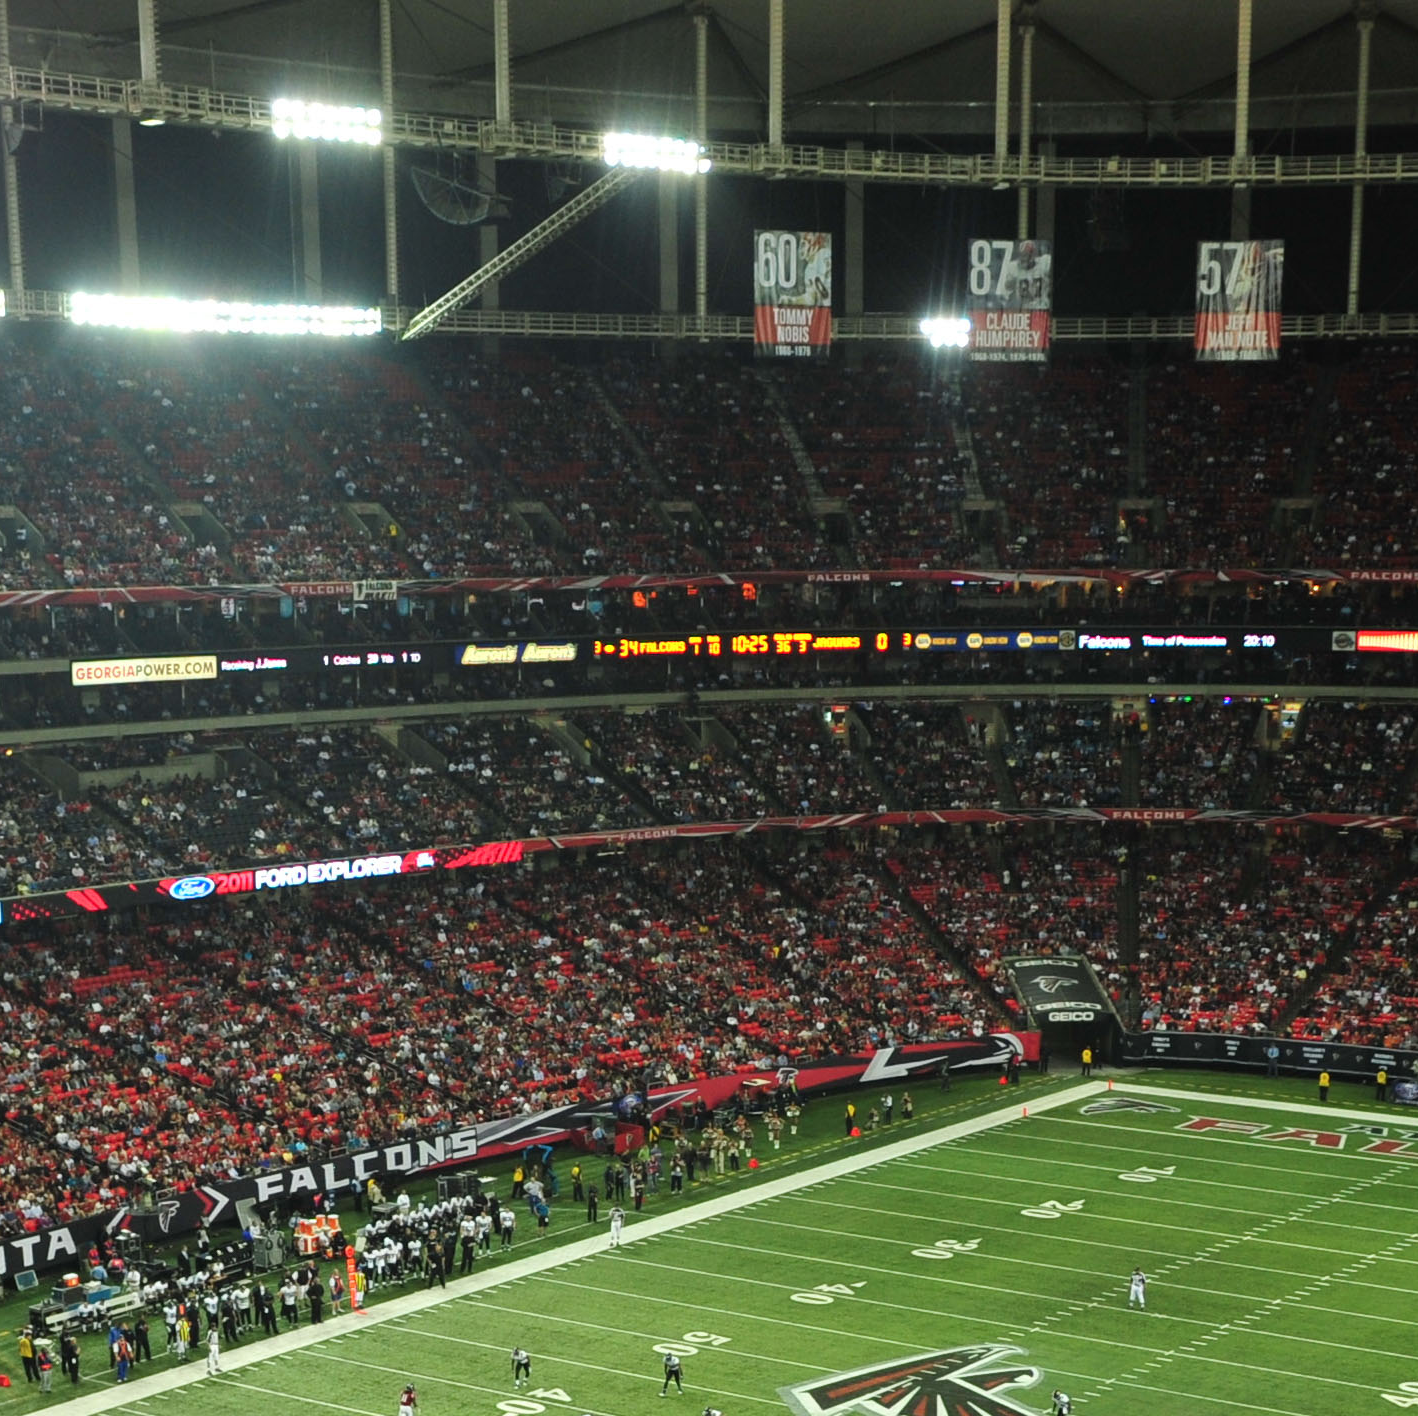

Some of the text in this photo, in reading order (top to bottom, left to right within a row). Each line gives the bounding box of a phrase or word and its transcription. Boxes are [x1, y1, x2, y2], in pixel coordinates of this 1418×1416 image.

[758, 233, 797, 288] 60
[971, 240, 1014, 295] 87
[1199, 243, 1244, 295] 57
[773, 309, 813, 324] TOMMY
[986, 313, 1030, 330] CLAUDE
[1225, 314, 1251, 330] JEFF
[776, 326, 810, 342] NOBIS
[976, 330, 1041, 347] HUMPHREY
[1208, 331, 1267, 347] VAN NOTE
[808, 573, 870, 582] FALCONS
[291, 586, 352, 595] FALCONS
[594, 641, 601, 653] 3
[619, 638, 639, 657] 34
[640, 640, 685, 653] FALCONS
[732, 635, 768, 652] 10:25
[776, 640, 791, 653] 36
[798, 640, 807, 652] 3
[812, 637, 861, 649] JAGUARS
[876, 634, 888, 650] 0
[902, 634, 911, 646] 3
[1079, 635, 1130, 649] Falcons
[1244, 636, 1274, 647] 20:10
[462, 643, 577, 664] Aaron's Aaron's
[694, 644, 699, 655] 1
[708, 642, 721, 655] 10
[323, 655, 329, 666] 1
[402, 651, 407, 663] 1
[410, 653, 420, 663] TD
[76, 661, 214, 680] GEORGIAPOWER.COM
[1113, 811, 1185, 819] FALCONS
[620, 829, 677, 841] FALCONS
[216, 872, 253, 895] 2011
[255, 866, 307, 889] FORD
[307, 855, 402, 884] EXPLORER
[1036, 1002, 1101, 1010] GEICO
[1049, 1012, 1094, 1021] GEICO
[255, 1127, 477, 1202] FALCONS
[1118, 1165, 1173, 1183] 10
[1021, 1200, 1081, 1219] 20
[911, 1240, 974, 1259] 30
[791, 1282, 858, 1305] 40
[653, 1331, 732, 1357] 50
[498, 1388, 572, 1415] 40
